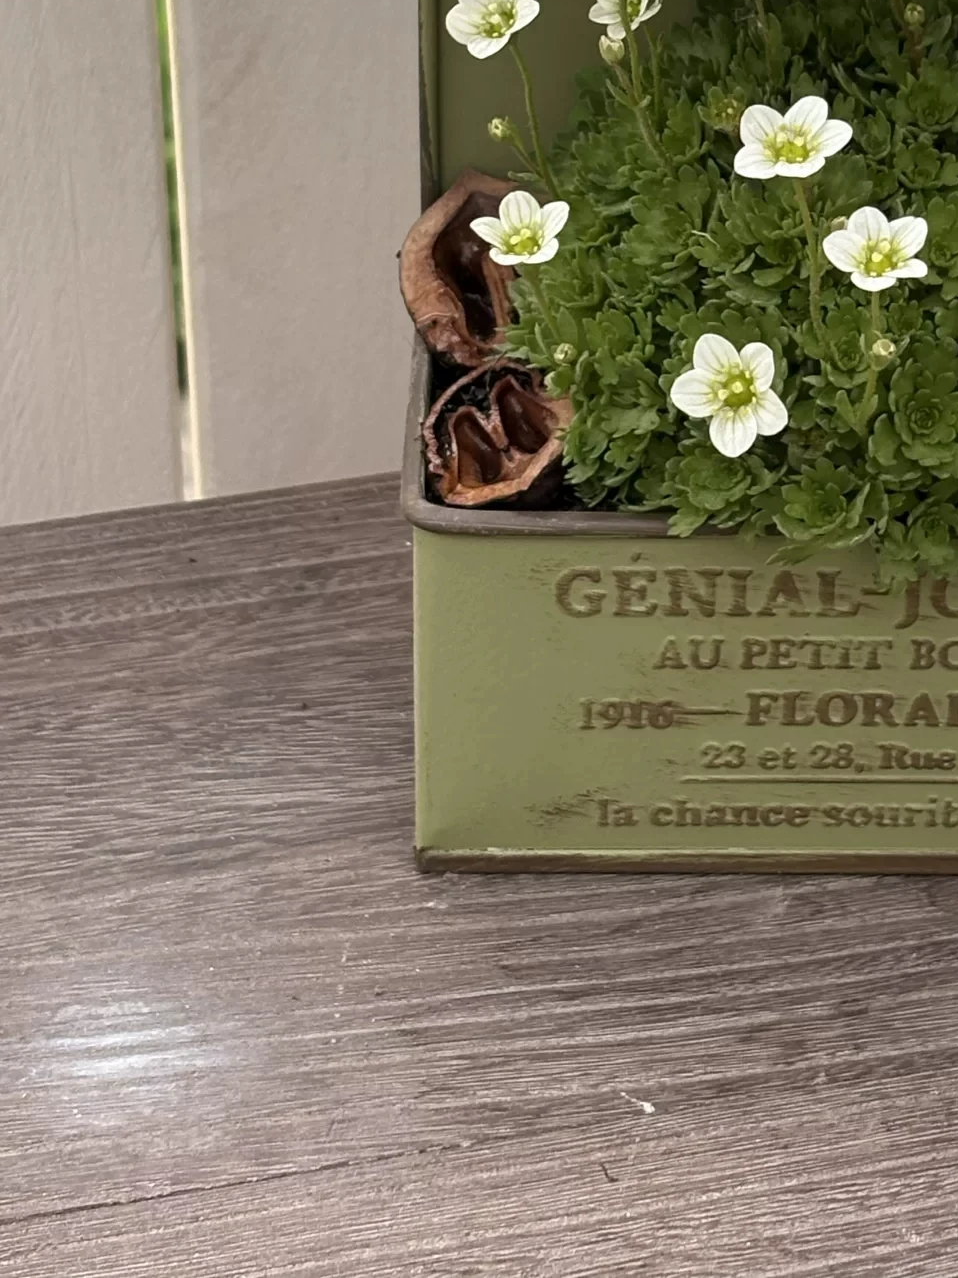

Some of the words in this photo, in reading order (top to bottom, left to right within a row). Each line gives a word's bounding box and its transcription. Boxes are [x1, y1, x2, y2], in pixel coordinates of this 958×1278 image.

[653, 635, 726, 670] AU
[740, 634, 892, 670] PETIT
[701, 742, 746, 769] 23
[757, 745, 798, 770] et
[810, 742, 865, 773] 28,
[878, 743, 956, 771] Rue
[649, 796, 810, 827] chance
